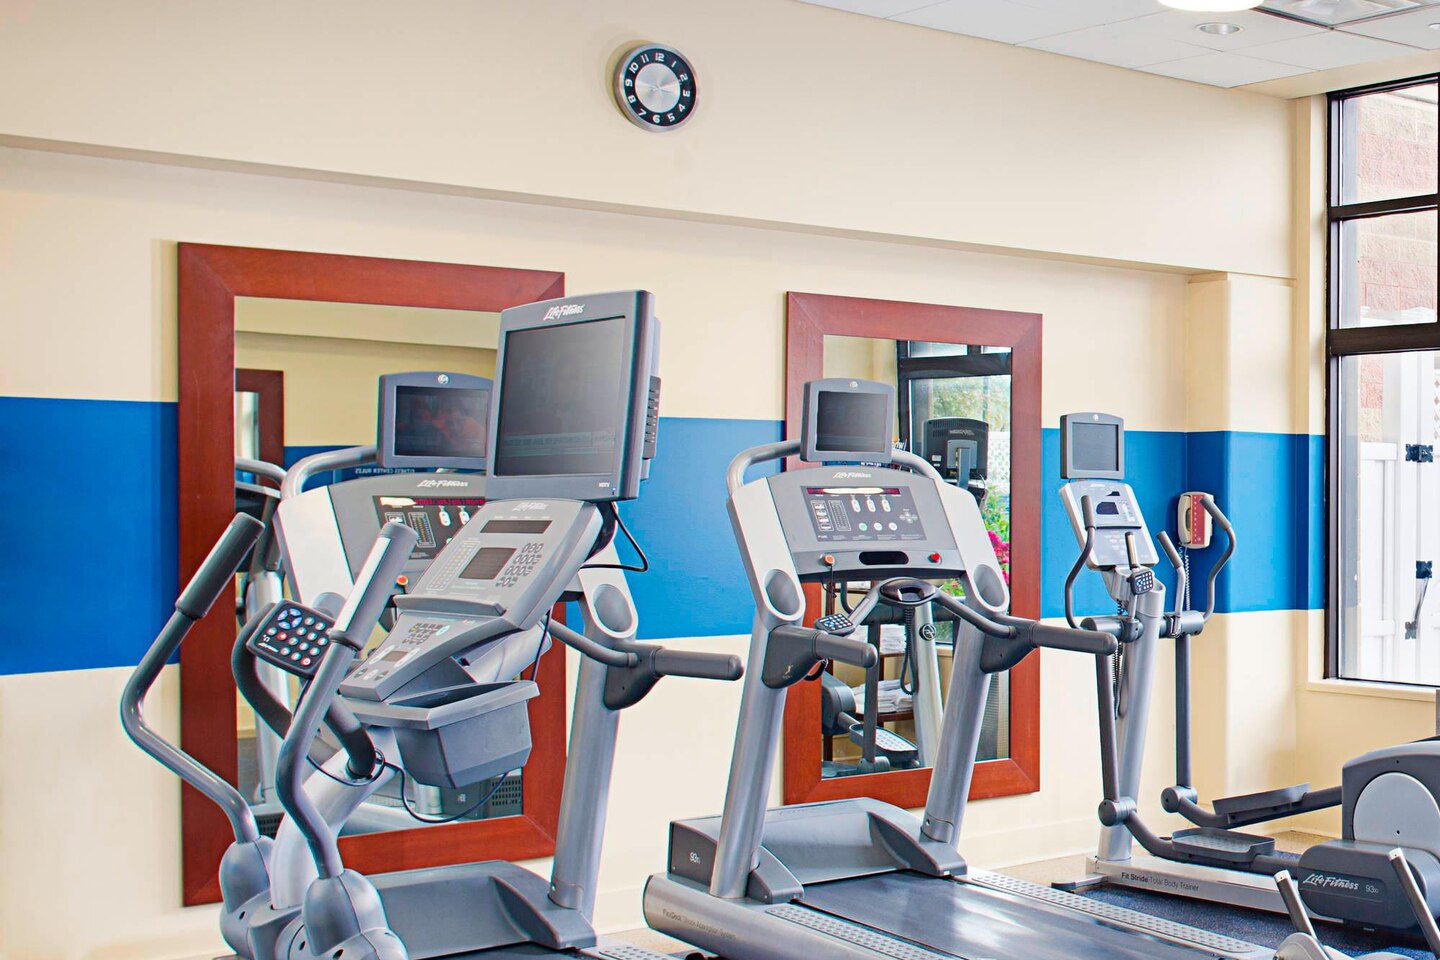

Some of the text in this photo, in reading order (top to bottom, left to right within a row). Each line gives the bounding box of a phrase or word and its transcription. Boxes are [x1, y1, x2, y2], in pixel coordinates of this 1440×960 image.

[640, 54, 650, 64] 11
[655, 52, 665, 62] 12
[628, 63, 639, 74] 10
[671, 60, 677, 68] 1
[680, 73, 688, 82] 2
[624, 78, 633, 87] 9
[682, 90, 691, 98] 3
[628, 95, 636, 104] 8
[678, 103, 686, 112] 4
[652, 114, 661, 123] 6
[667, 113, 676, 122] 5
[1131, 874, 1148, 882] Stride
[1165, 879, 1178, 888] Body
[1180, 882, 1199, 891] Trainer
[1302, 874, 1325, 885] Life
[1322, 876, 1358, 890] Fitness
